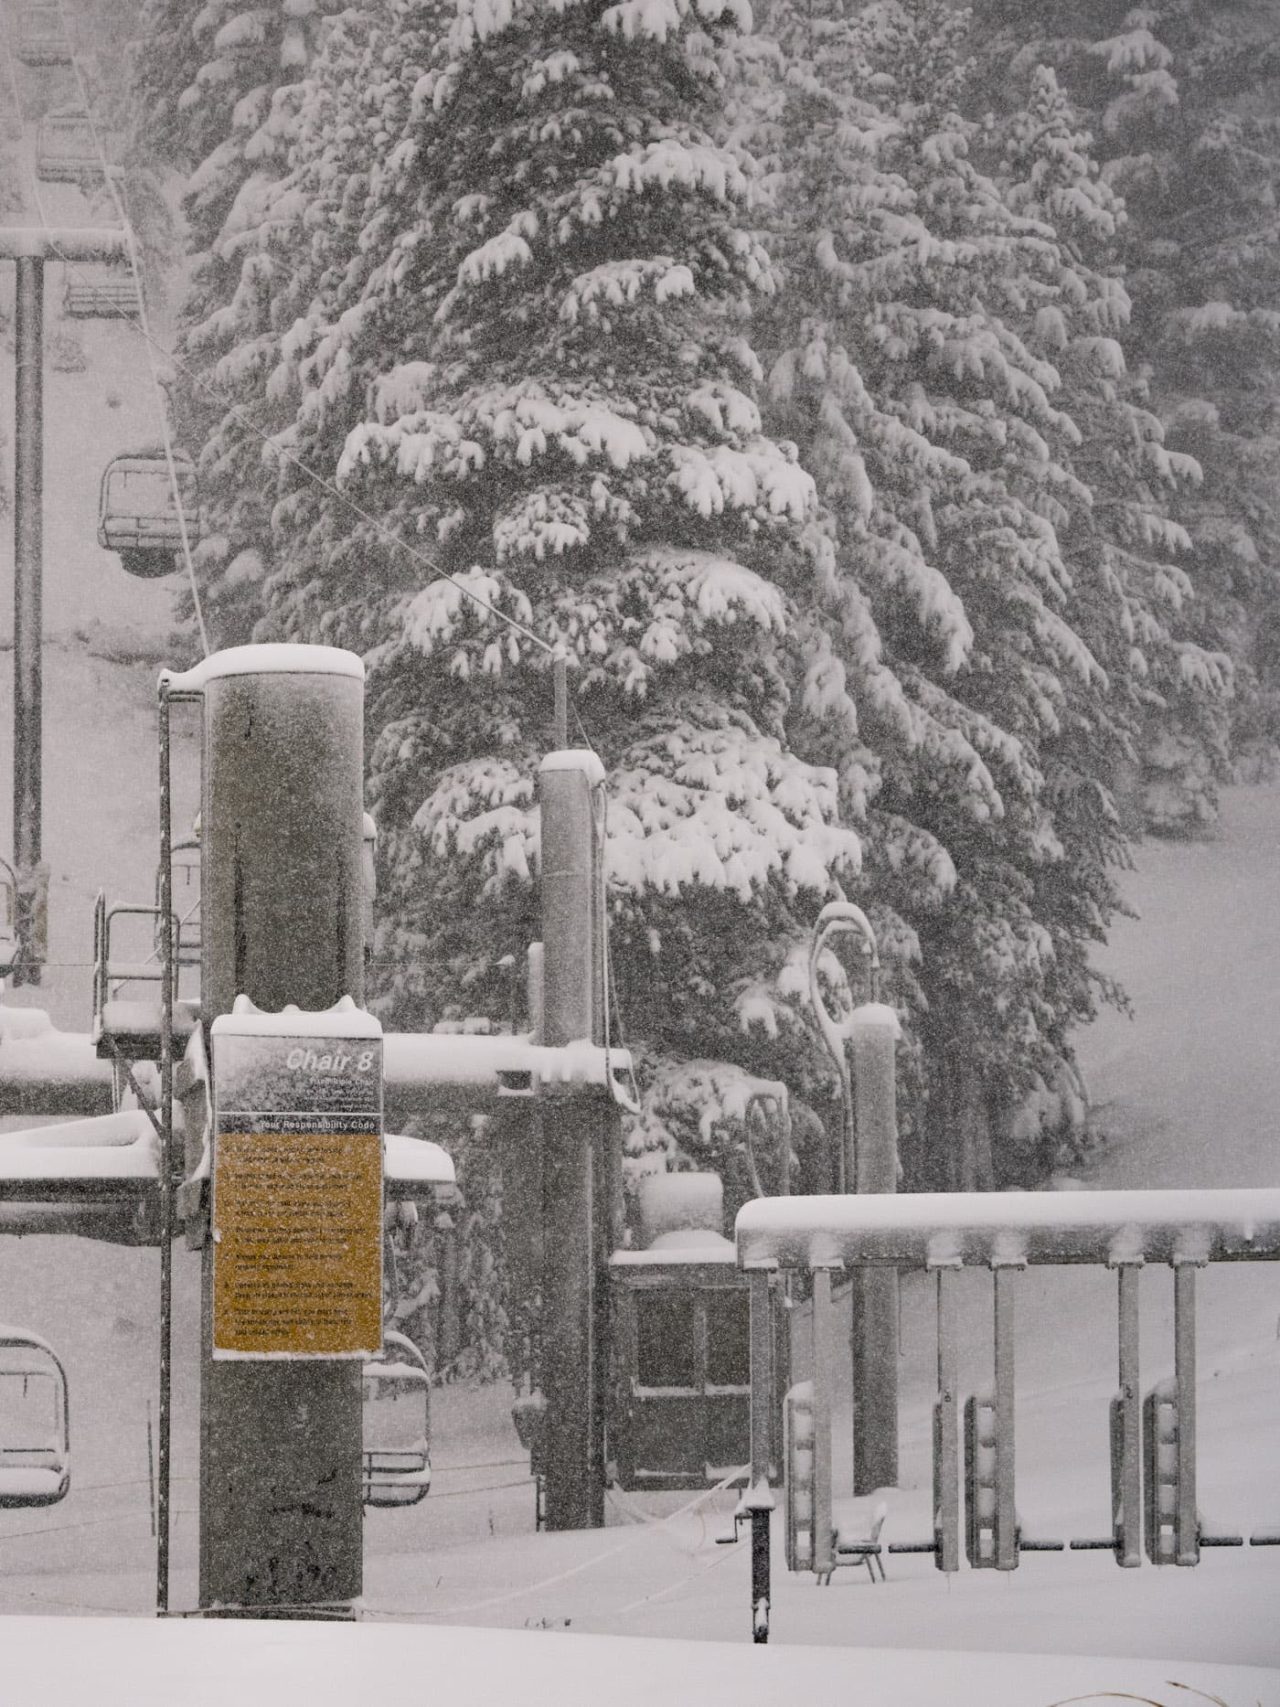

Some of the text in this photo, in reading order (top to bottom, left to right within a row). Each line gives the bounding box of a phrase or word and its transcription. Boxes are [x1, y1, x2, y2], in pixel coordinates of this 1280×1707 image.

[287, 1049, 374, 1071] Chair 8
[260, 1120, 375, 1130] Your Responsibility Code
